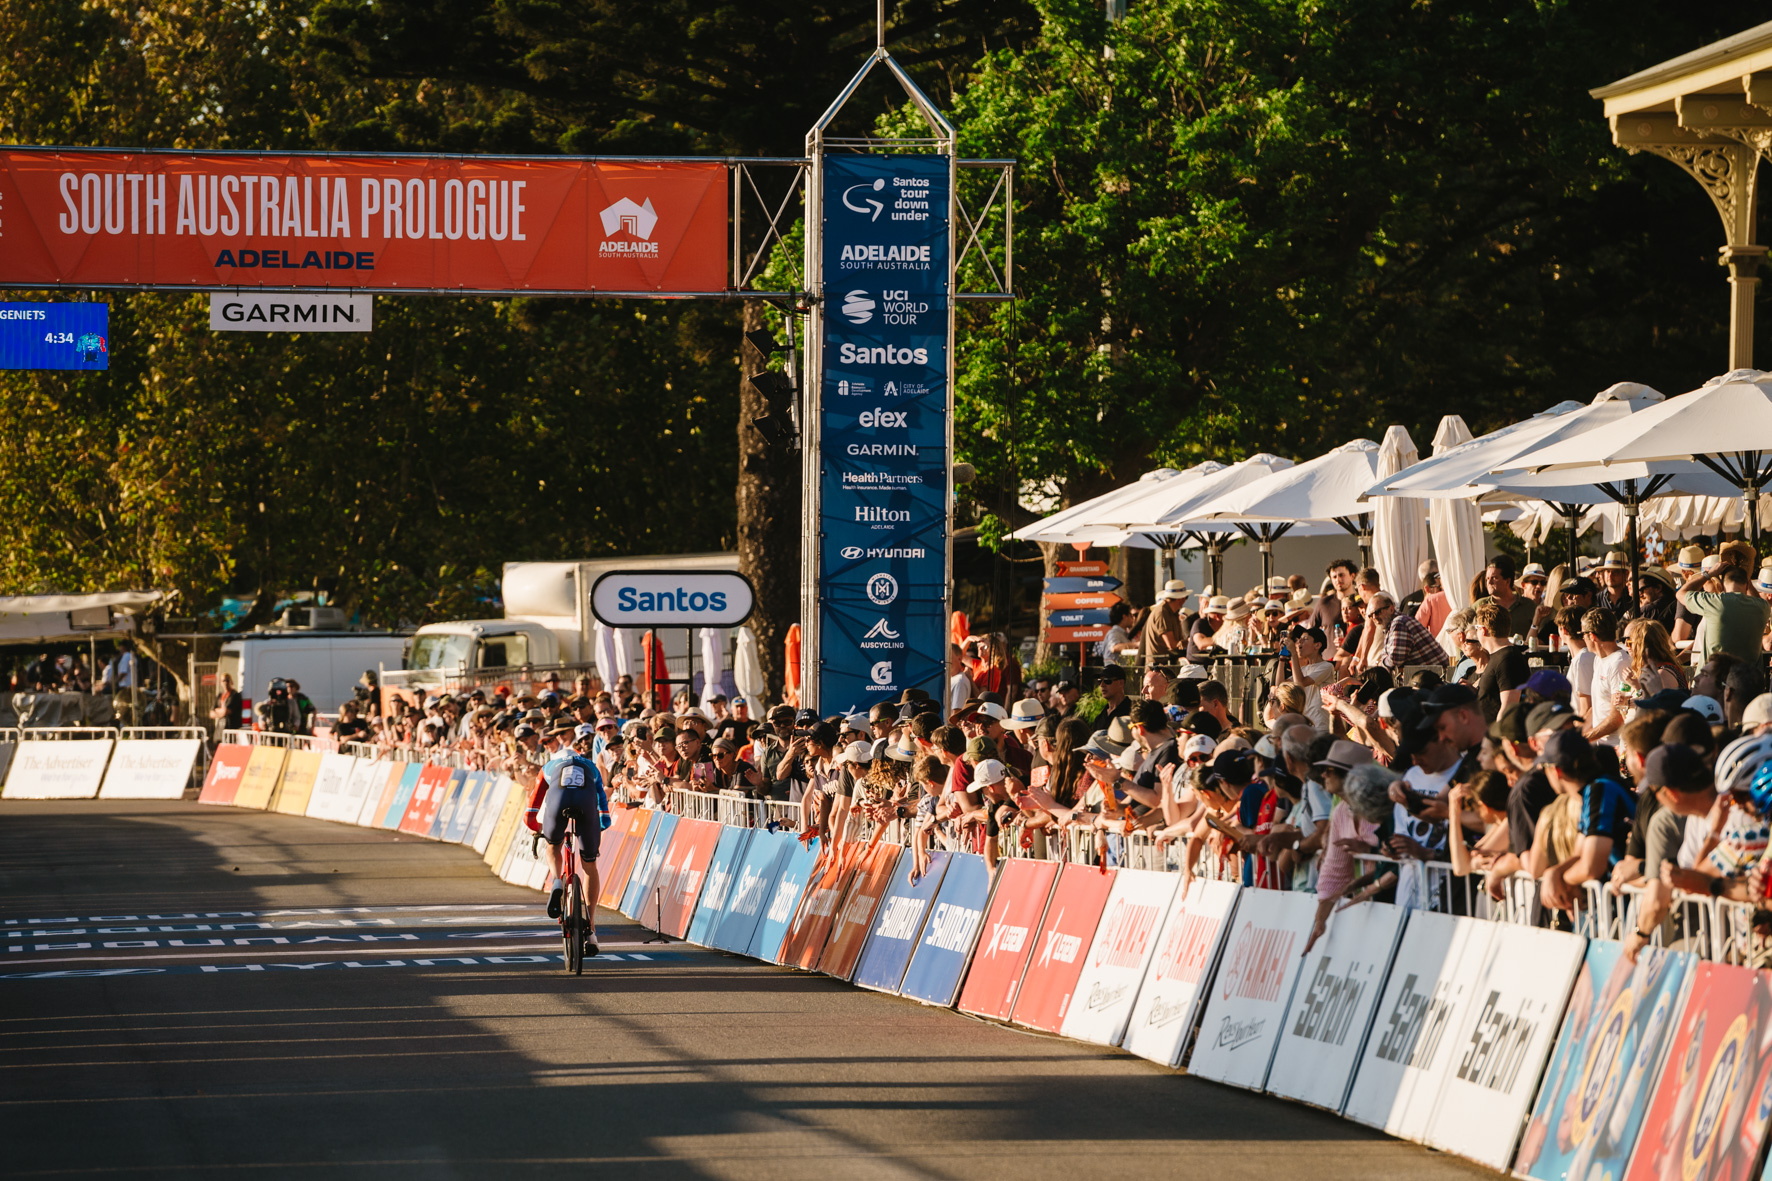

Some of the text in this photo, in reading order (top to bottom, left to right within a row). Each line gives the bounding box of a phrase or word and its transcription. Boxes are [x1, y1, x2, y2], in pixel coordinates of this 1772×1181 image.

[893, 177, 930, 187] Santos
[901, 188, 929, 198] tour
[59, 172, 527, 241] SOUTH AUSTRALIA PROLOGUE
[894, 199, 929, 209] down
[891, 210, 929, 221] under
[599, 241, 659, 253] ADELAIDE
[840, 245, 931, 261] ADELAIDE
[214, 249, 375, 270] ADELAIDE
[877, 262, 931, 270] AUSTRALIA
[883, 290, 909, 301] UCI
[0, 309, 46, 320] GENIETS
[222, 302, 354, 323] GARMIN
[883, 302, 929, 313] WORLD
[883, 314, 917, 325] TOUR
[44, 332, 74, 344] 4:34
[840, 343, 929, 365] Santos
[858, 407, 908, 428] efex
[847, 444, 917, 456] GARMIN
[842, 472, 923, 484] Health Partners
[855, 506, 911, 522] Hilton
[867, 548, 925, 558] HYUNDAI
[618, 587, 727, 612] Santos
[1073, 630, 1103, 638] SANTOS
[860, 641, 904, 649] AUSCYCLING
[731, 864, 768, 917] Santos
[875, 895, 926, 941] SHIMANO
[8, 933, 421, 952] HYUNDAI
[1106, 903, 1160, 969] YAMAHA
[1167, 913, 1220, 984] YAMAHA
[199, 953, 655, 973] HYUNDAI
[1236, 927, 1296, 1003] YAMAHA
[1293, 956, 1375, 1046] Santini
[1375, 973, 1464, 1071] Santini
[1456, 990, 1548, 1095] Santini
